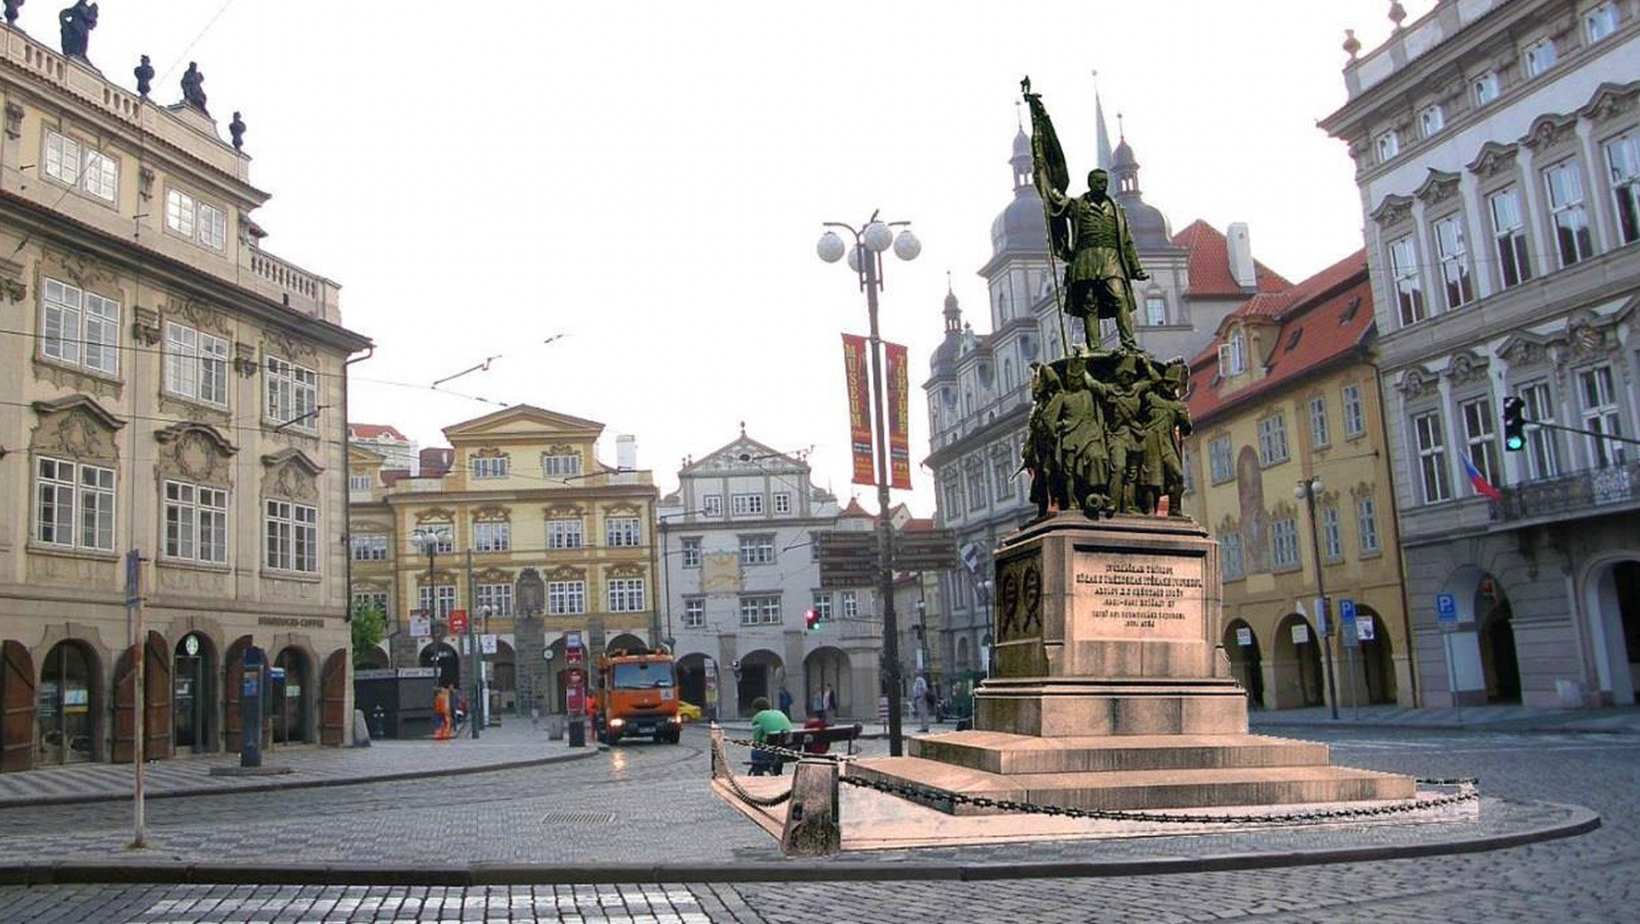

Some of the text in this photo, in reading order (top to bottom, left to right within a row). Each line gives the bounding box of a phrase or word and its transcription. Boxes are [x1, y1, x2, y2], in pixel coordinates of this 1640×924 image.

[845, 344, 862, 427] MUSEUM
[1342, 600, 1351, 616] P
[1440, 596, 1450, 612] P
